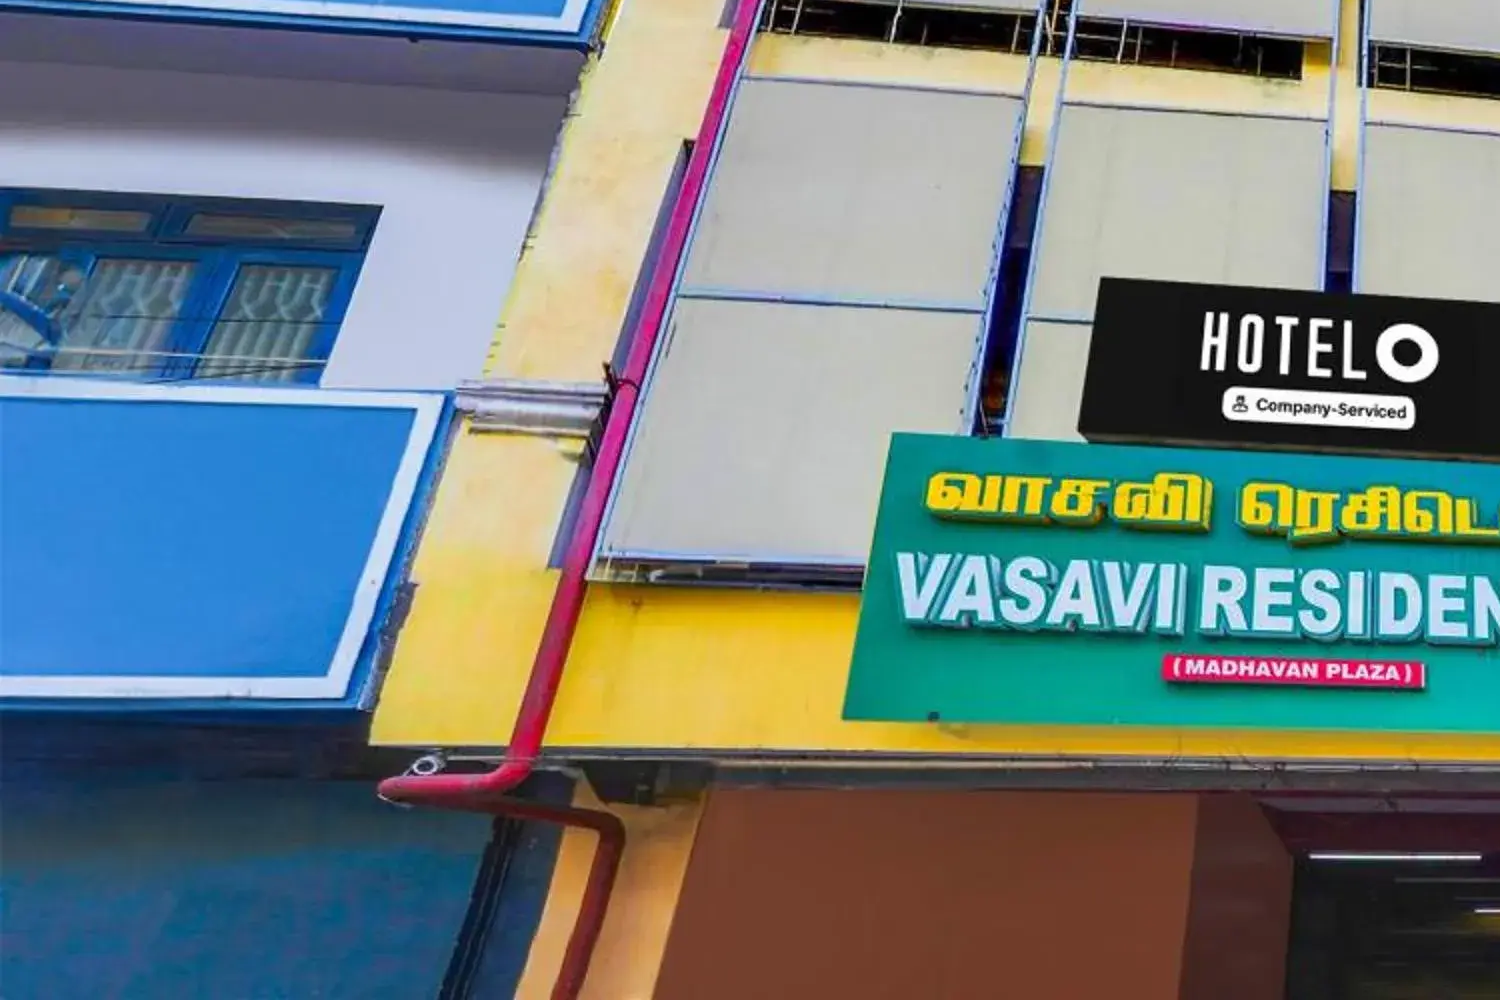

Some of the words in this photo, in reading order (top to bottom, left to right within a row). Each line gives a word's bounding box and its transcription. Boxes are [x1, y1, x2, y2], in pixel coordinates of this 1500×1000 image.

[1200, 311, 1367, 380] HOTEL
[1375, 322, 1440, 383] O
[1255, 397, 1407, 420] Company-Serviced
[925, 472, 1210, 527] வாசவி
[895, 551, 1186, 634] VASAVI
